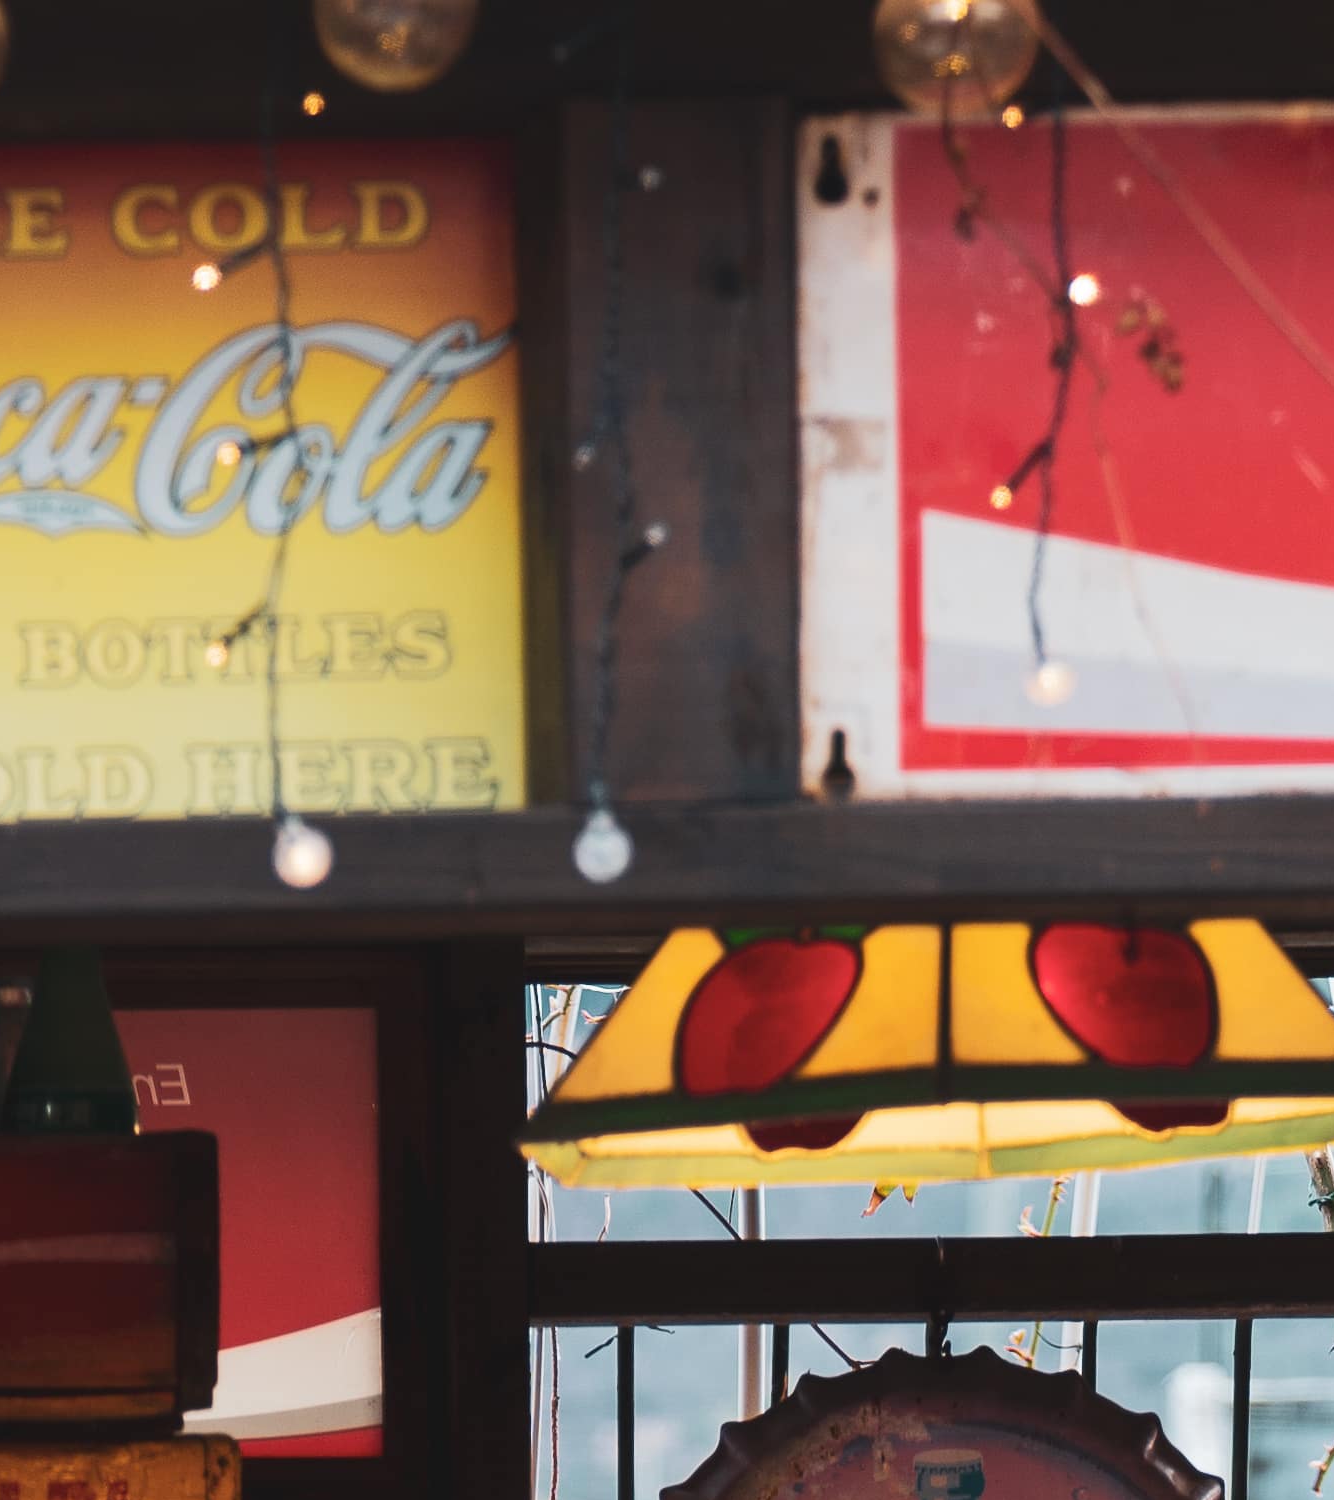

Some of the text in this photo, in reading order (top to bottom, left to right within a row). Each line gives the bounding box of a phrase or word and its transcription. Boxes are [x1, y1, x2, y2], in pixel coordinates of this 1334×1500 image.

[111, 180, 430, 254] COLD
[15, 610, 453, 690] BOTTLES
[184, 738, 499, 822] HERE
